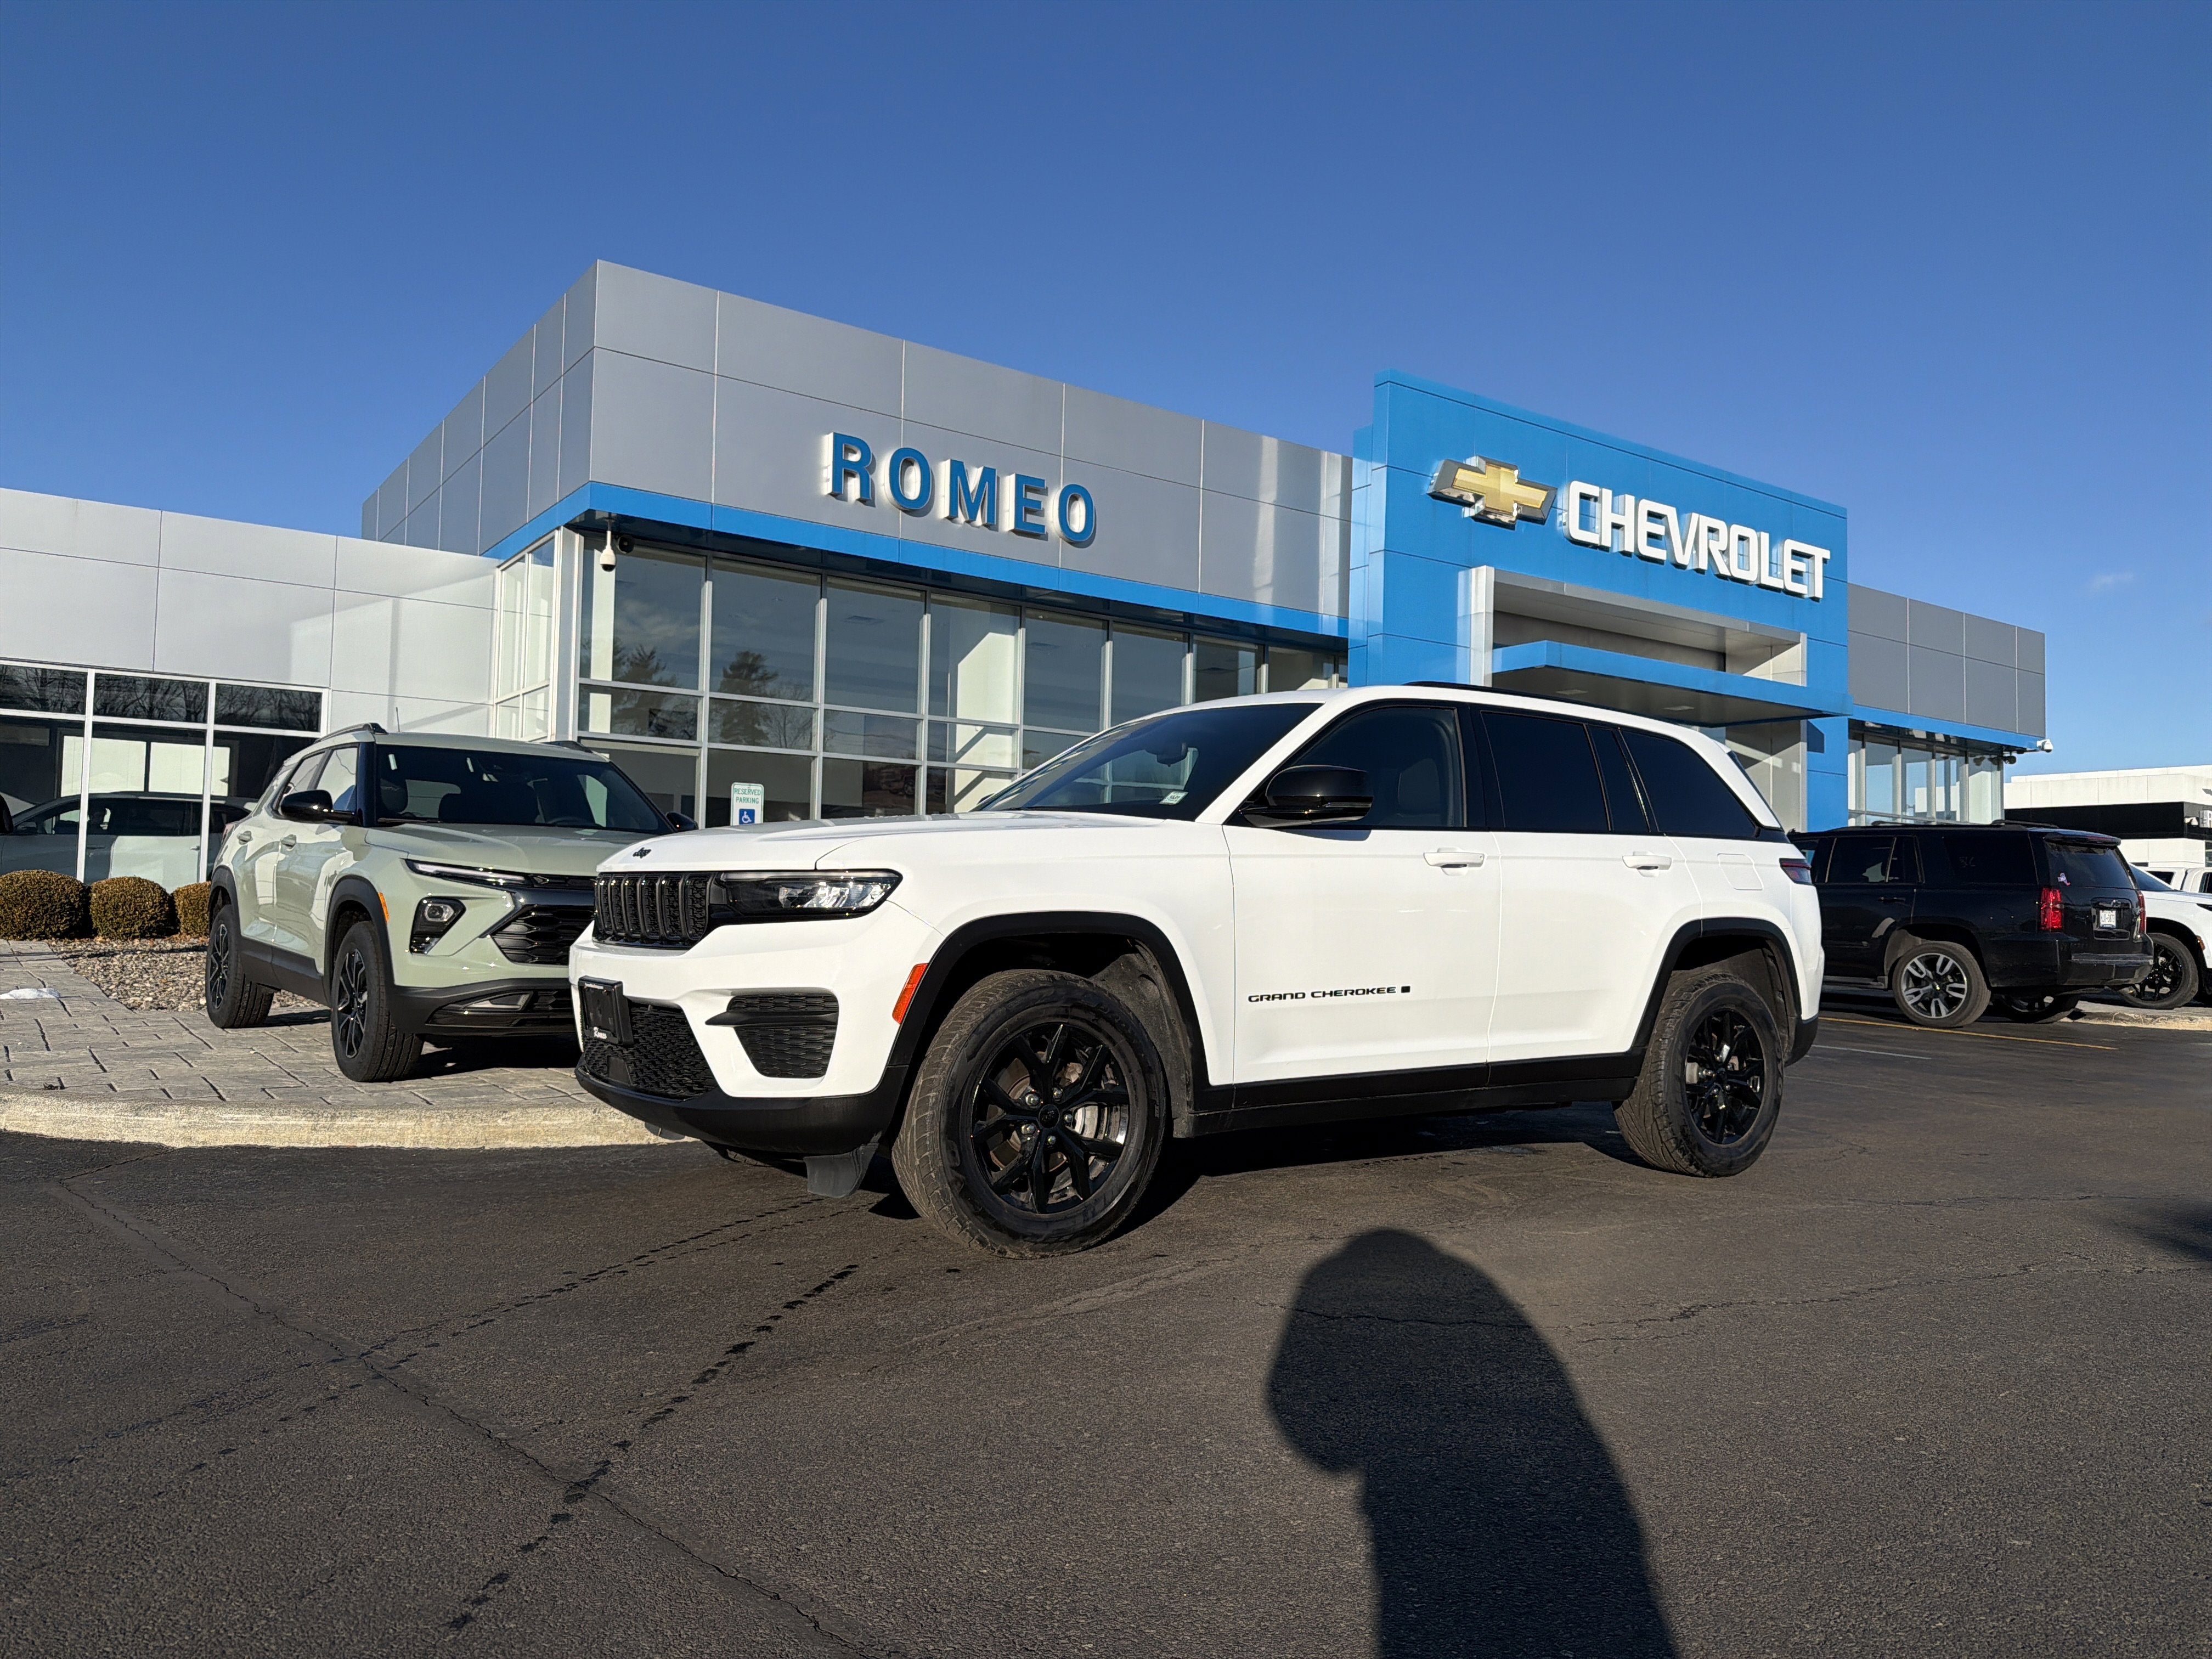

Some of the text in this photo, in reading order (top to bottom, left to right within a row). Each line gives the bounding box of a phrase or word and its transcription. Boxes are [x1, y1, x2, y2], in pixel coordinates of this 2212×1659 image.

[827, 432, 1095, 542] ROMEO
[1566, 481, 1830, 601] CHEVROLET
[734, 788, 761, 796] RESERVED
[1248, 986, 1397, 1003] GRAND CHEROKEE
